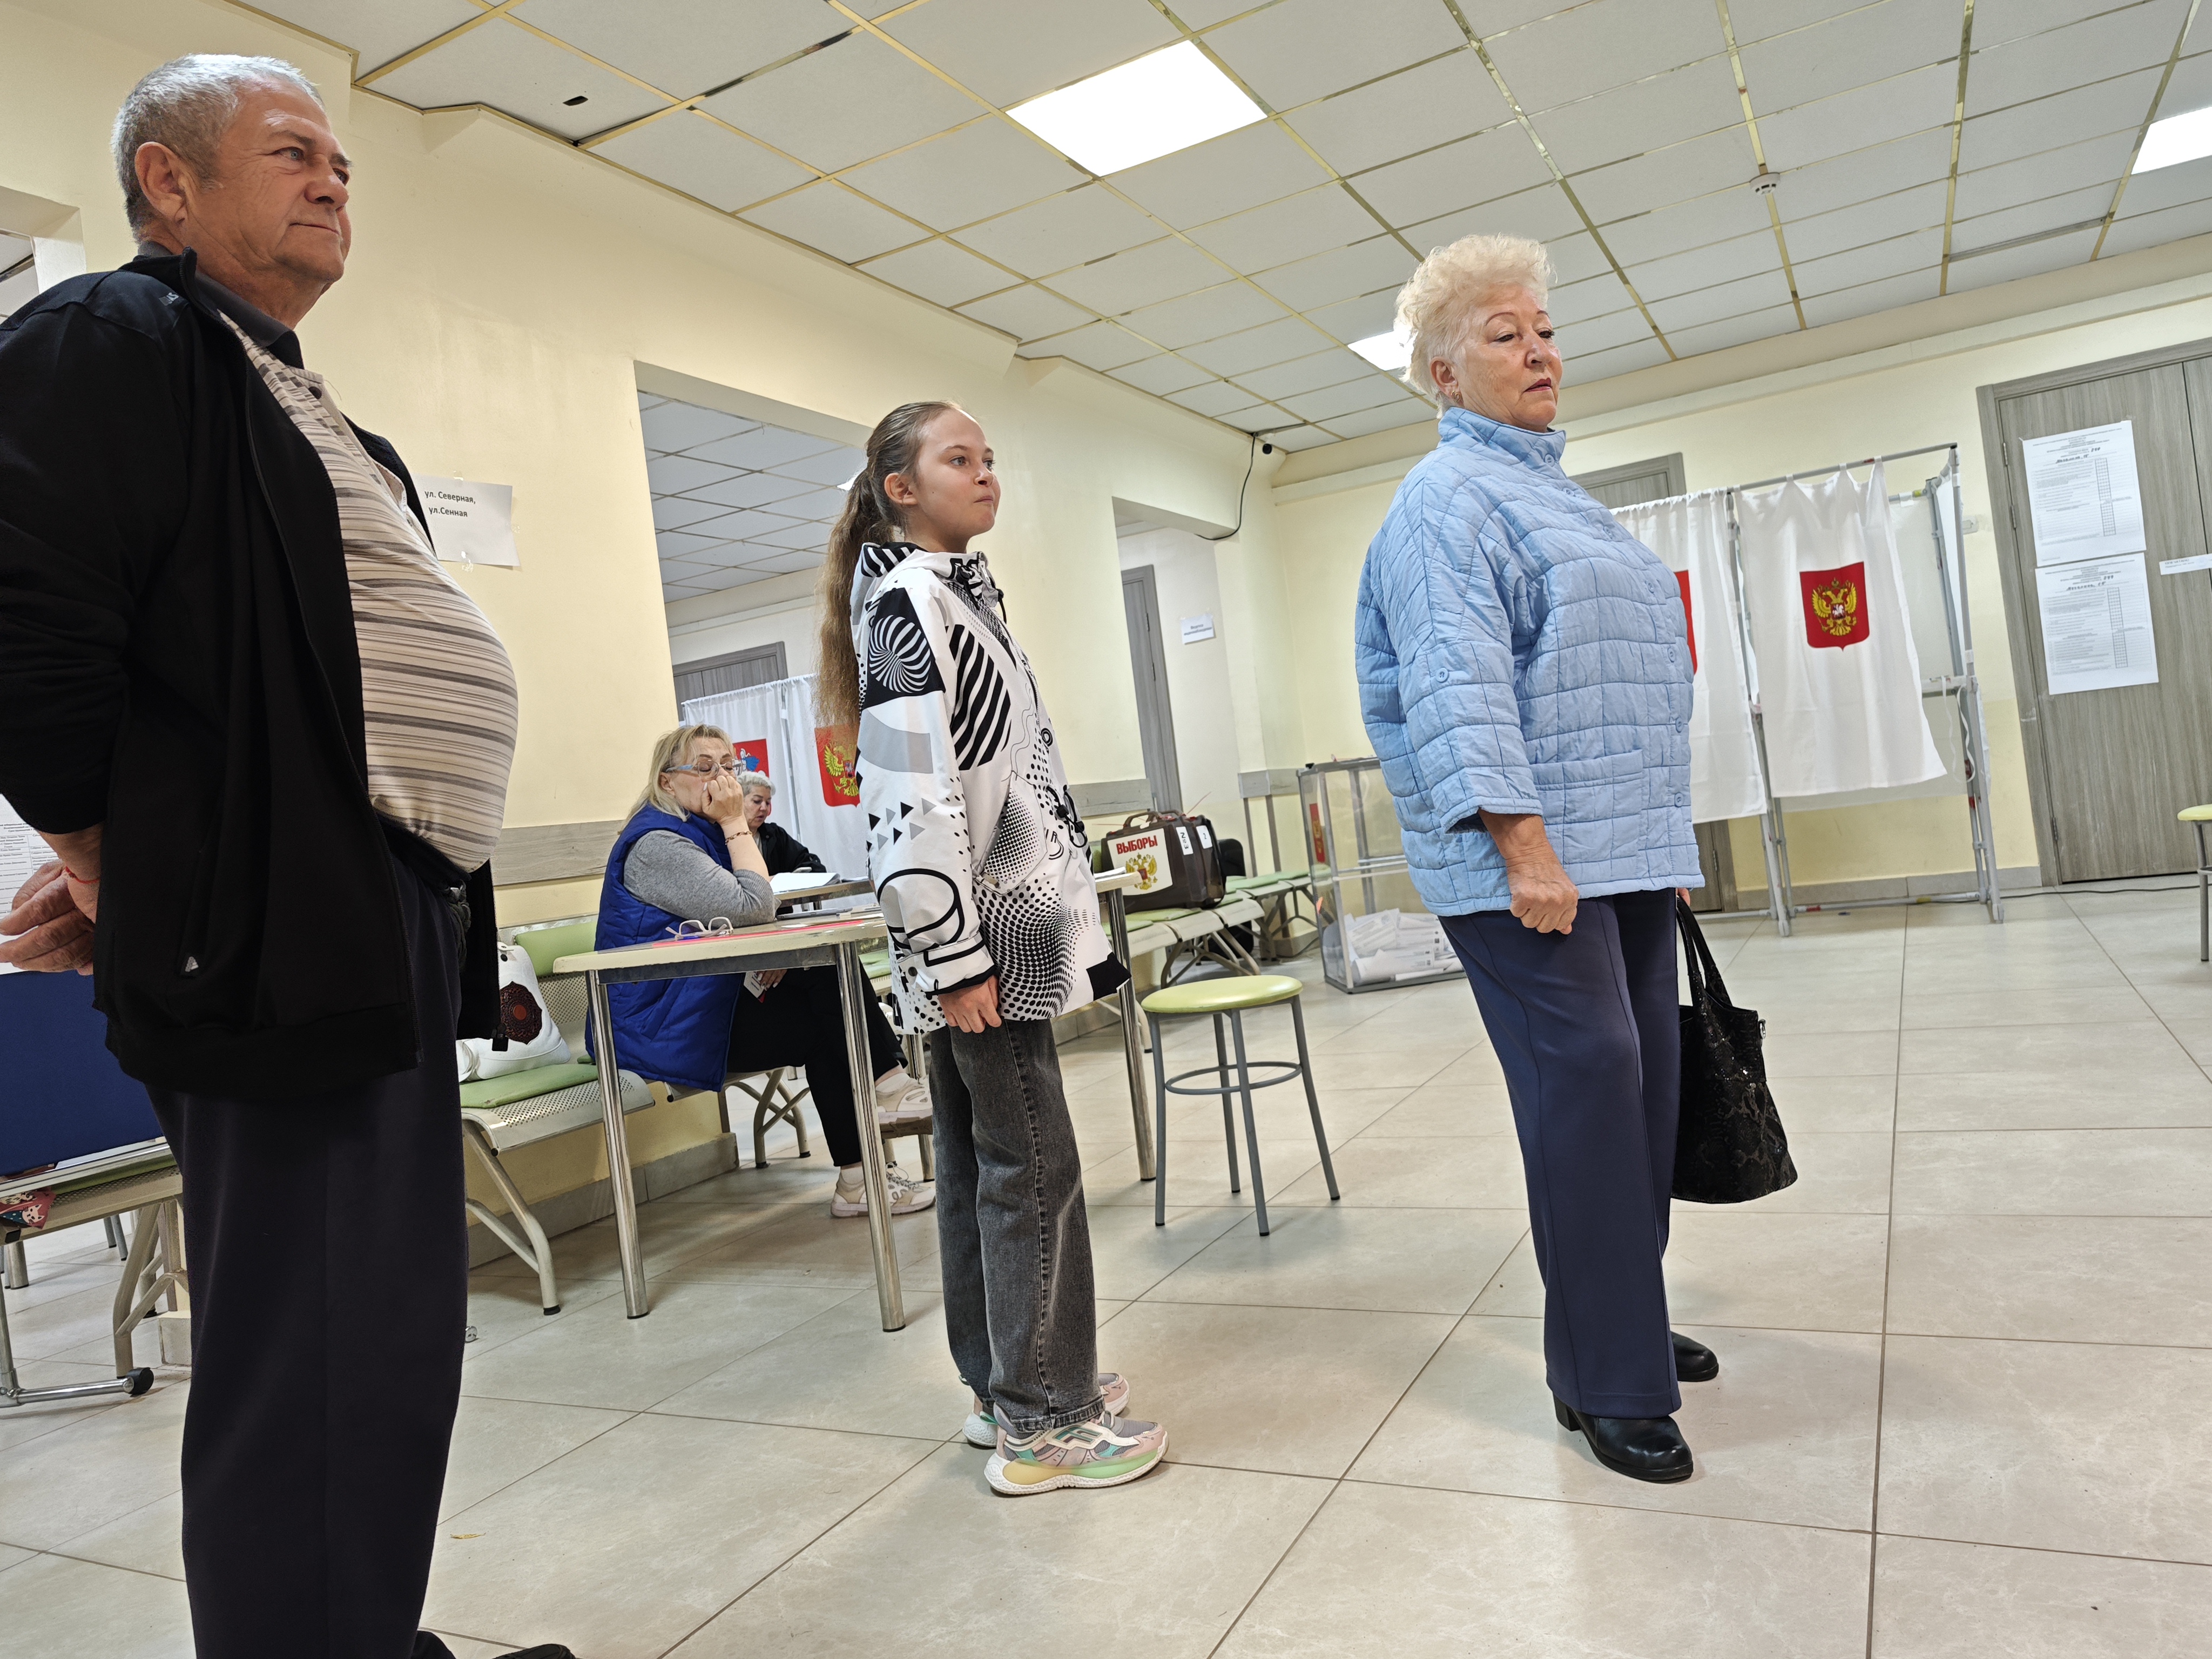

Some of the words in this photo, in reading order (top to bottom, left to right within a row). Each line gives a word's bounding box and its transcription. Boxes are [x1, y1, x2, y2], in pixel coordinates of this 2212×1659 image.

[438, 491, 476, 504] Северная,
[429, 507, 468, 517] ул.Сенная
[1116, 835, 1158, 854] ВЫБОРЫ
